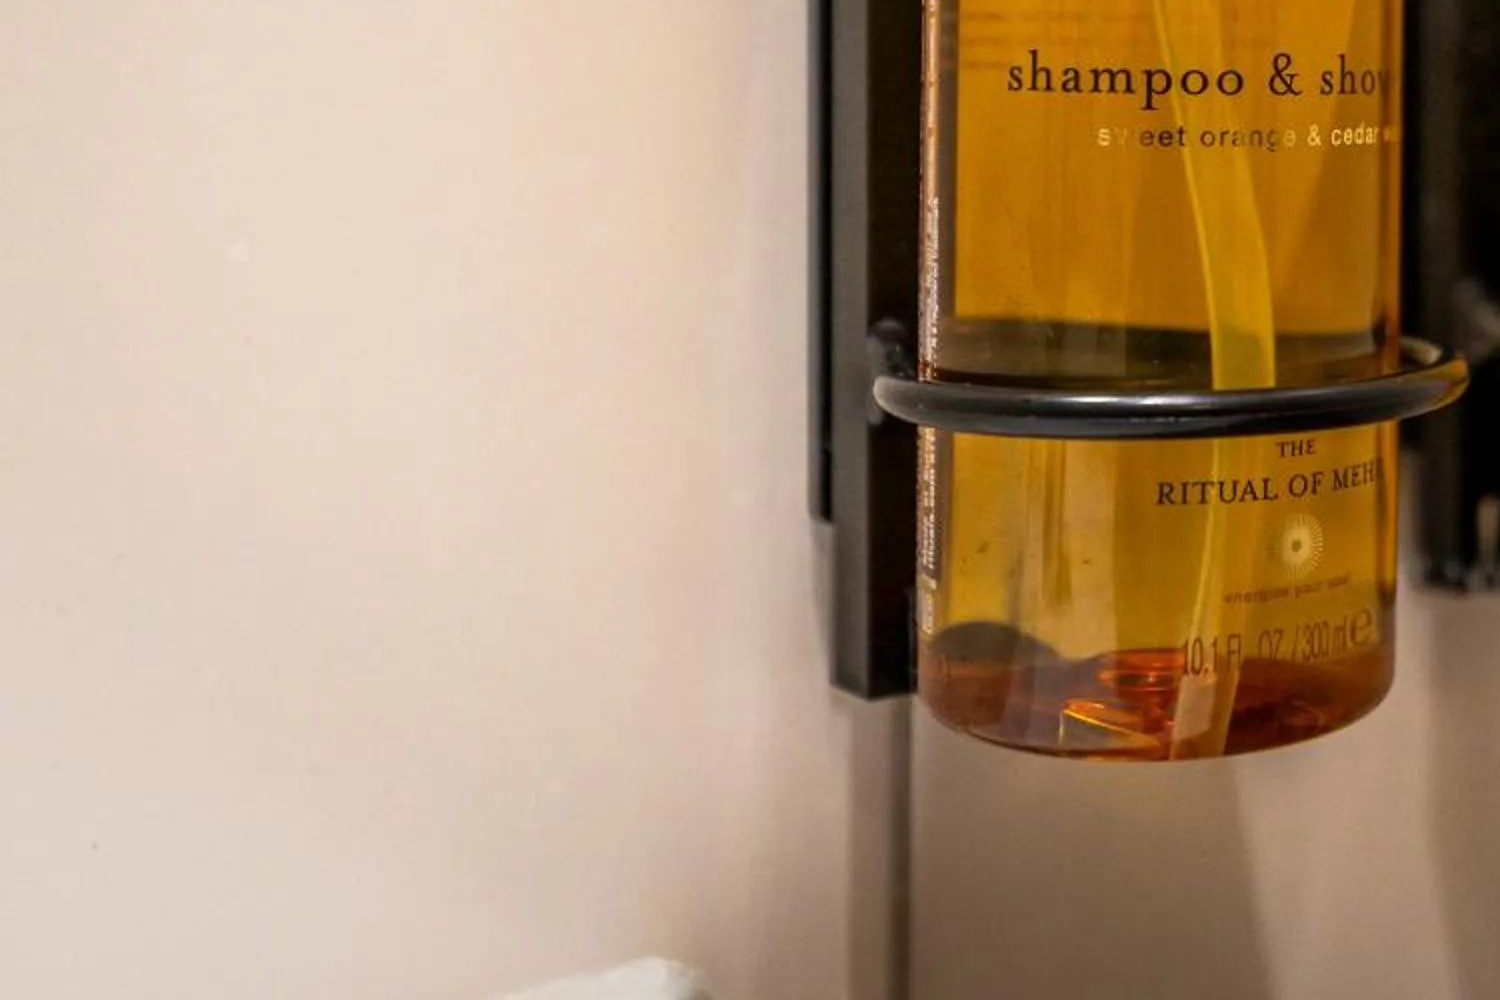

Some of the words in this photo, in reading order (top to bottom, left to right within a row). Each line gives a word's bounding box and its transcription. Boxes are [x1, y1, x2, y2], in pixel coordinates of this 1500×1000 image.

[1007, 49, 1245, 111] shampoo
[1268, 52, 1303, 97] &
[1200, 128, 1297, 152] orange
[1307, 123, 1322, 147] &
[1275, 438, 1316, 459] THE
[1156, 477, 1279, 506] RITUAL
[1288, 471, 1325, 499] OF
